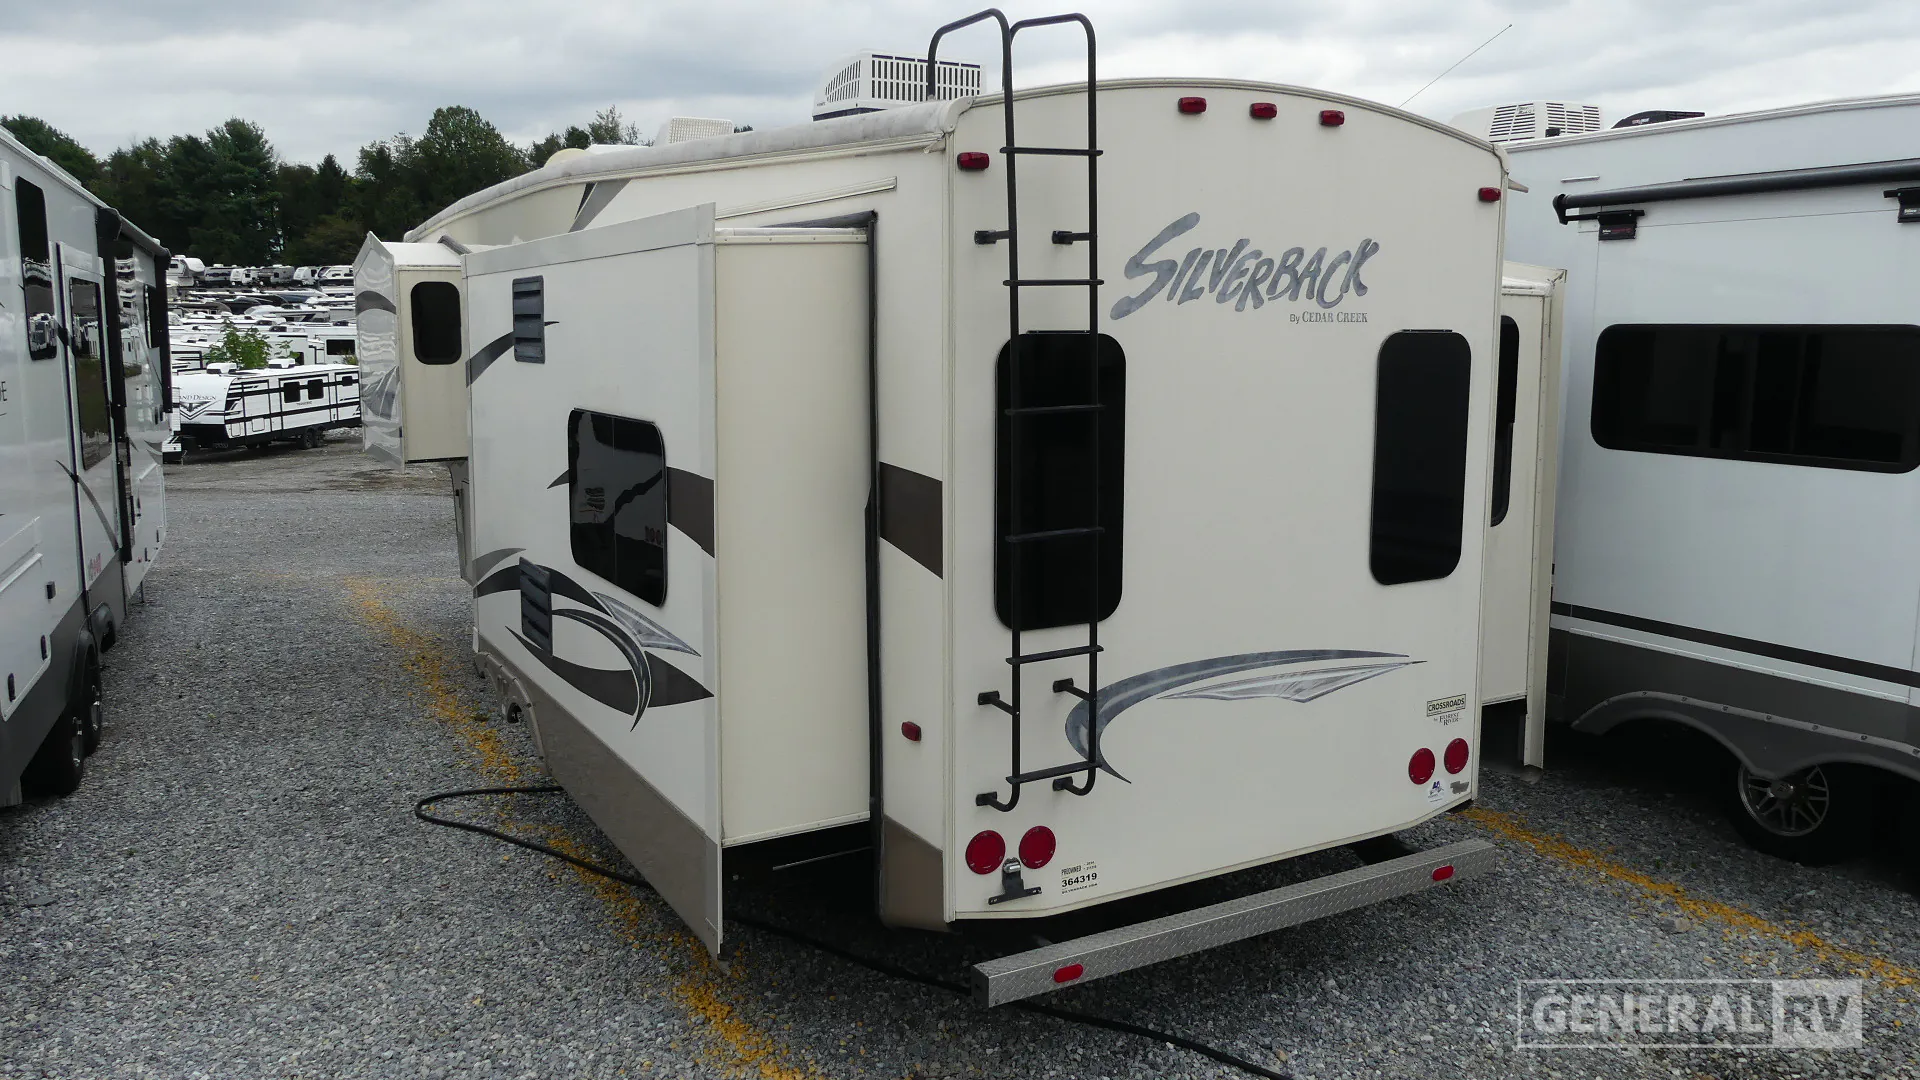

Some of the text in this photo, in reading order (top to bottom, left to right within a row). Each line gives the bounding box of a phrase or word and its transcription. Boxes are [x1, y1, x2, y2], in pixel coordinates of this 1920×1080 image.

[1110, 212, 1379, 320] SILVERBACK
[1289, 311, 1368, 324] By CEDAR CREEK
[1428, 697, 1465, 712] CROSSROADS
[1061, 872, 1098, 888] 364319
